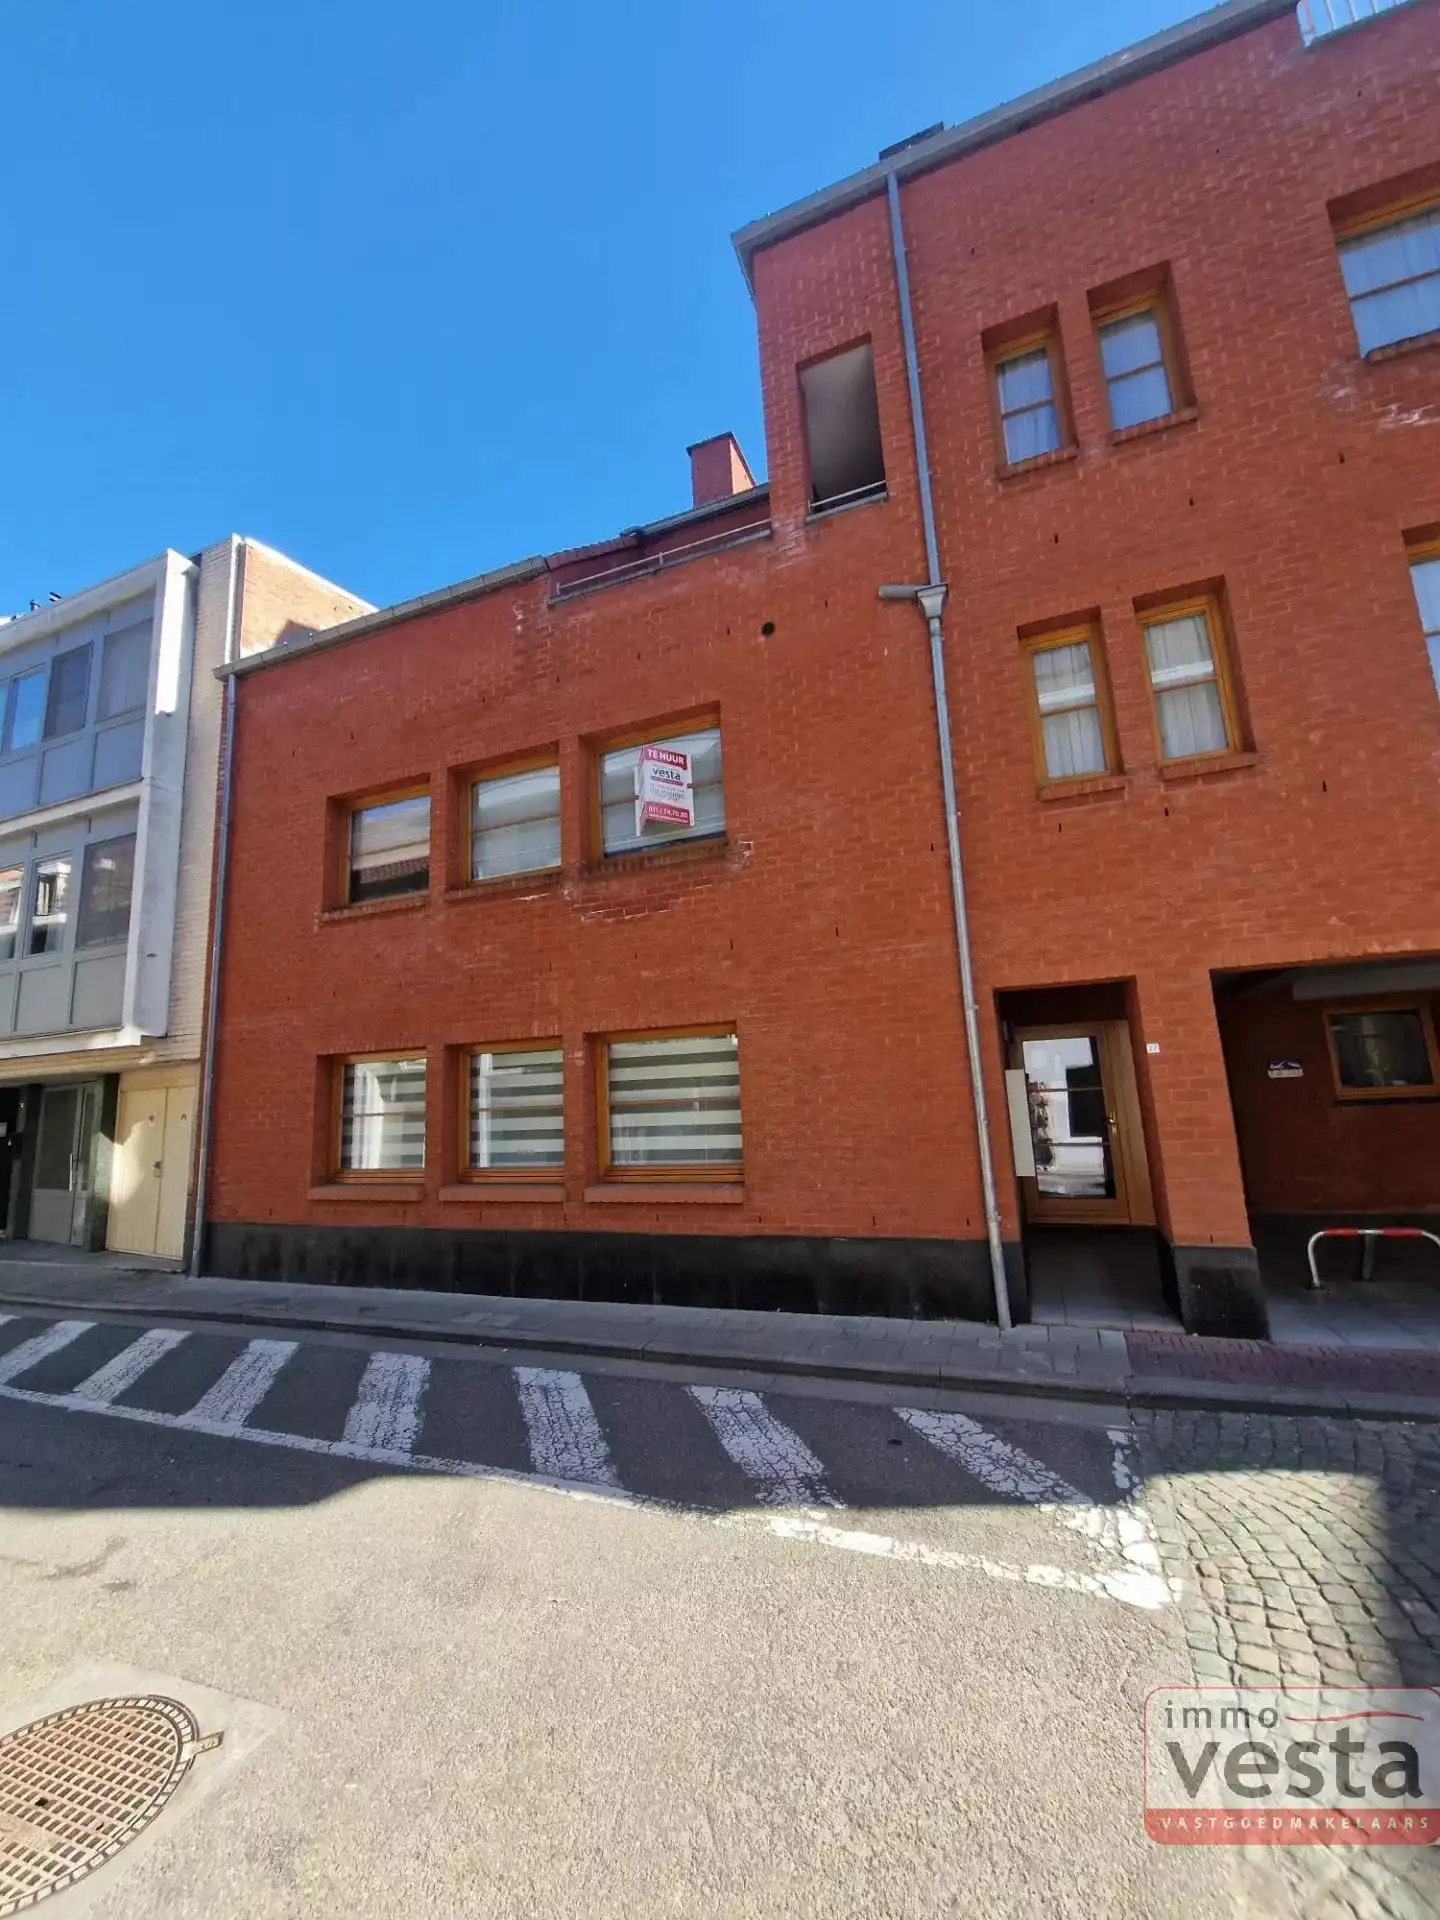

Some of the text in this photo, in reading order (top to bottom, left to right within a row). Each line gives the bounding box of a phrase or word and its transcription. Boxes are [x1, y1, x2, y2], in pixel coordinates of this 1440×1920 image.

[647, 749, 685, 764] TE HUUR
[653, 767, 681, 780] vesta
